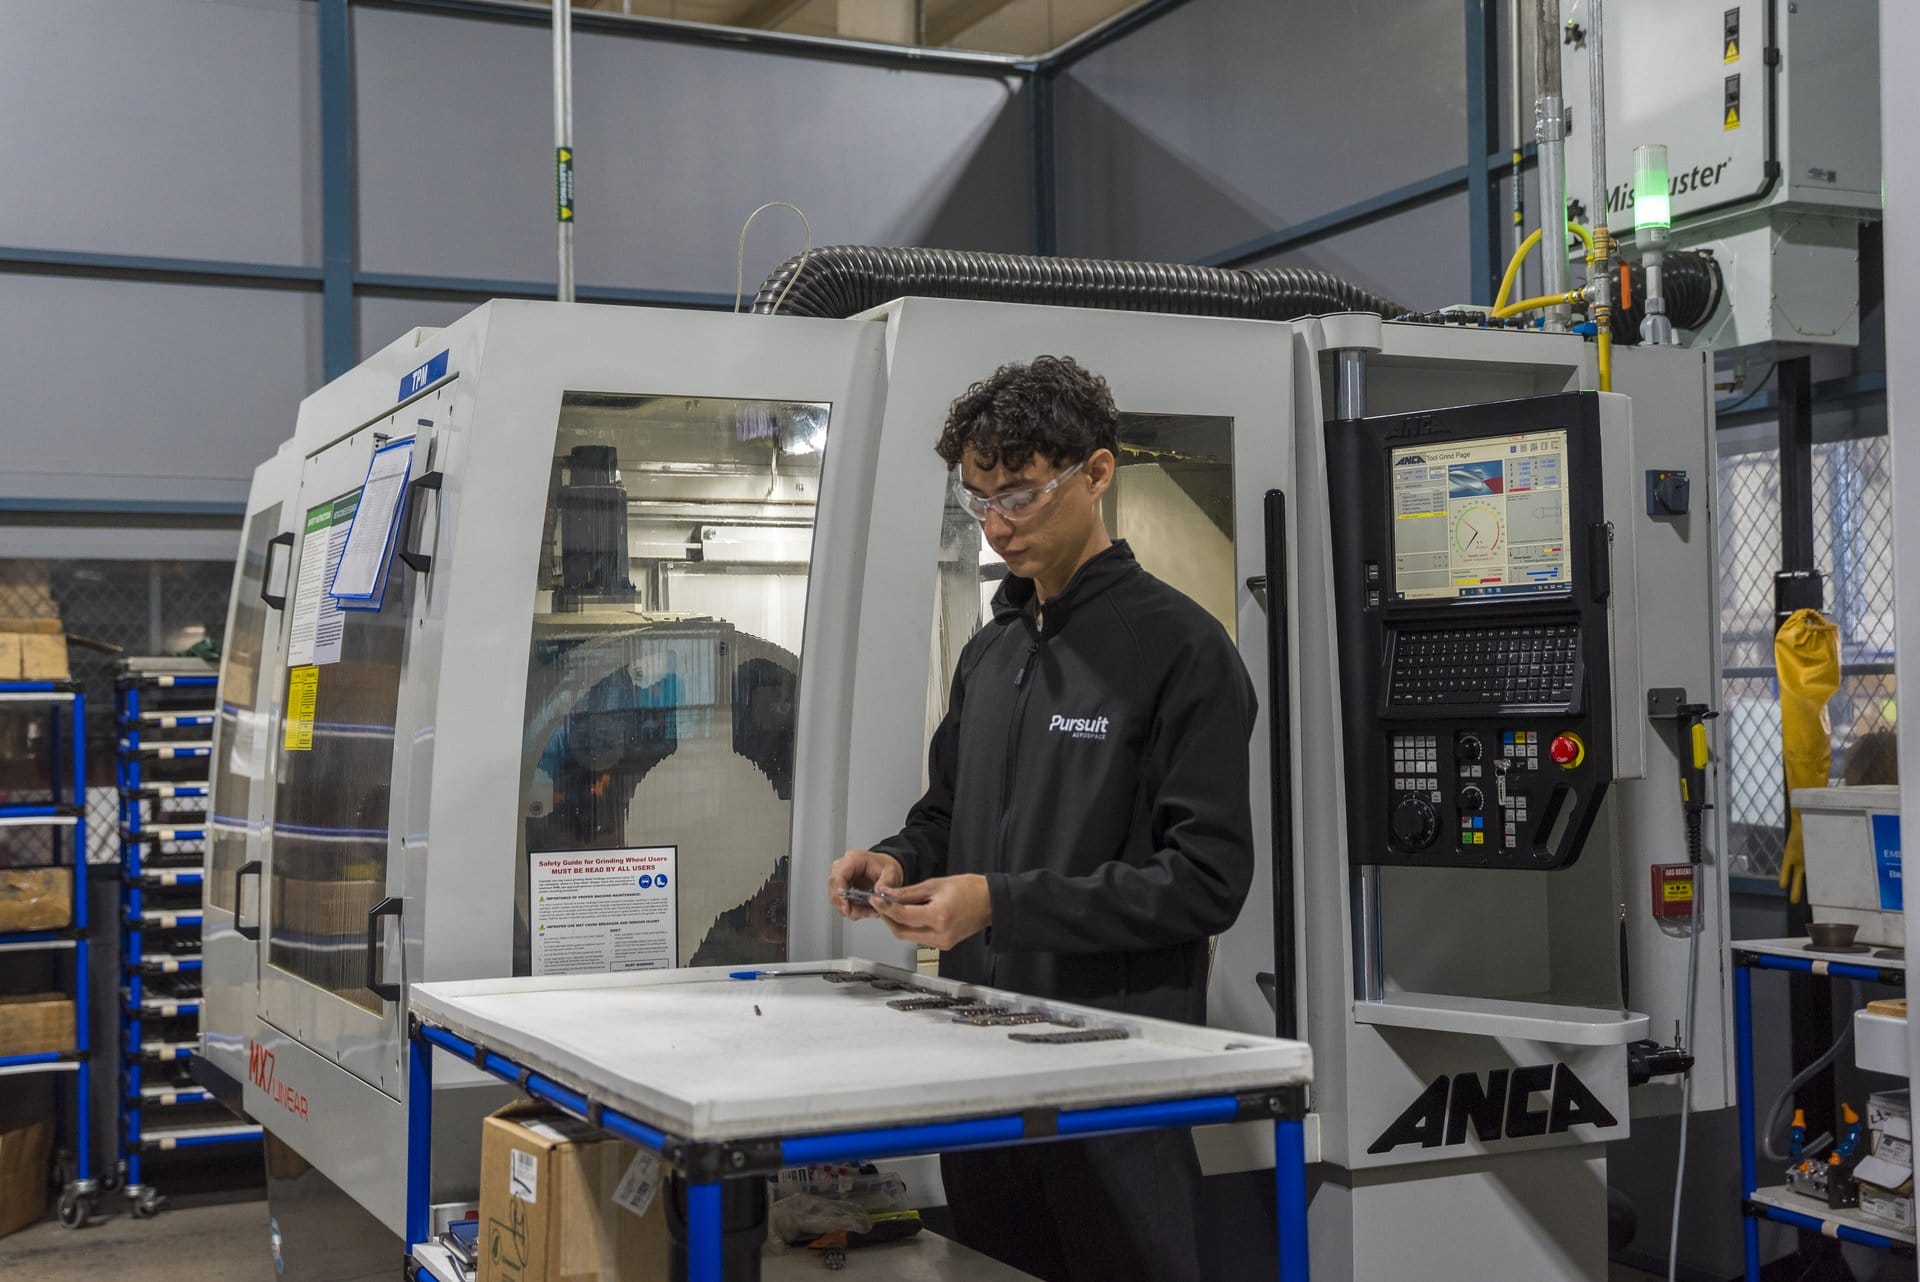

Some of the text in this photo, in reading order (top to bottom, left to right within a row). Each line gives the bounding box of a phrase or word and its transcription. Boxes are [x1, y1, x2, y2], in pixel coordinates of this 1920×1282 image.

[412, 364, 429, 392] TPM
[1394, 455, 1426, 466] ANCA
[1455, 451, 1471, 460] Page
[1049, 714, 1110, 733] Pursuit
[1072, 732, 1106, 740] AEROSPACE
[249, 1040, 309, 1122] MX7 LINEAR
[1367, 1062, 1617, 1154] ANCA
